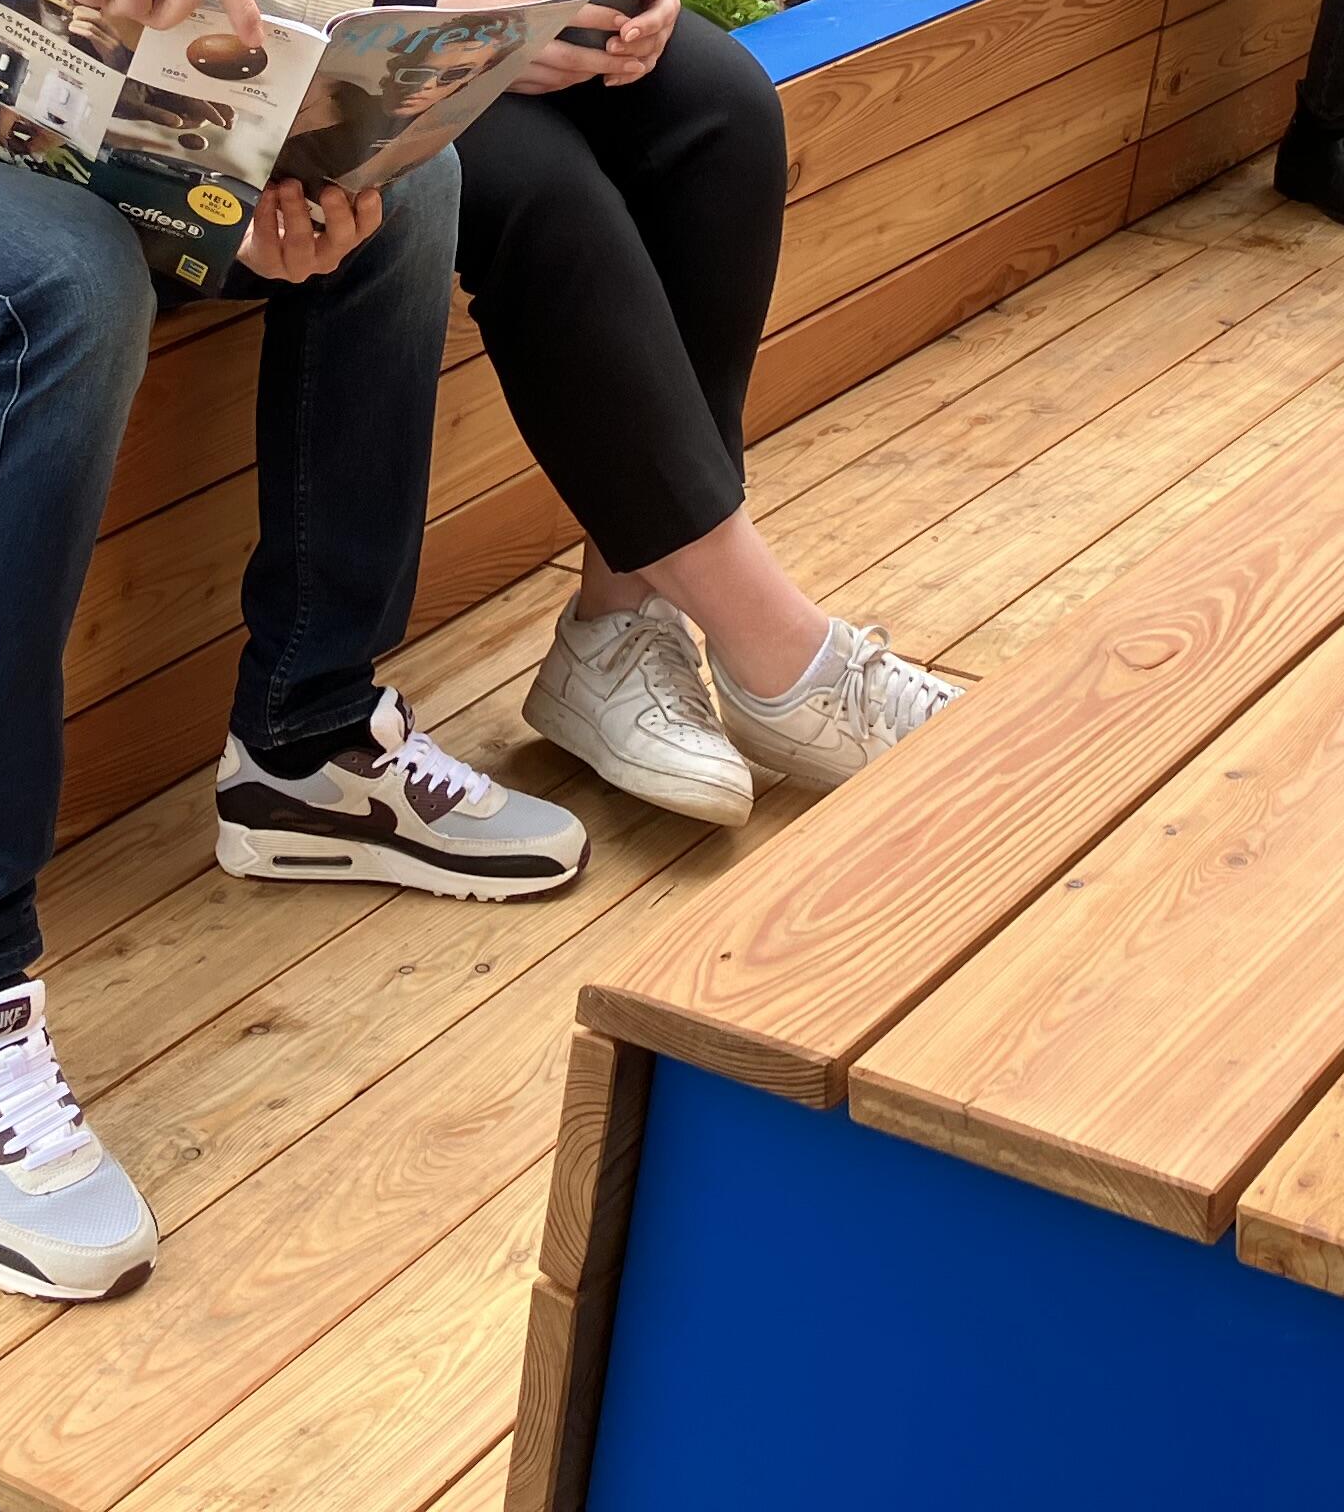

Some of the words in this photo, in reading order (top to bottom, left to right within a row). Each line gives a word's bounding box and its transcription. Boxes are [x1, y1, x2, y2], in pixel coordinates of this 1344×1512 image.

[15, 20, 106, 78] KAPSEL-SYSTEM
[39, 45, 82, 75] KAPSEL
[161, 66, 188, 79] 100%
[242, 85, 268, 99] 100%
[202, 191, 233, 209] NEU
